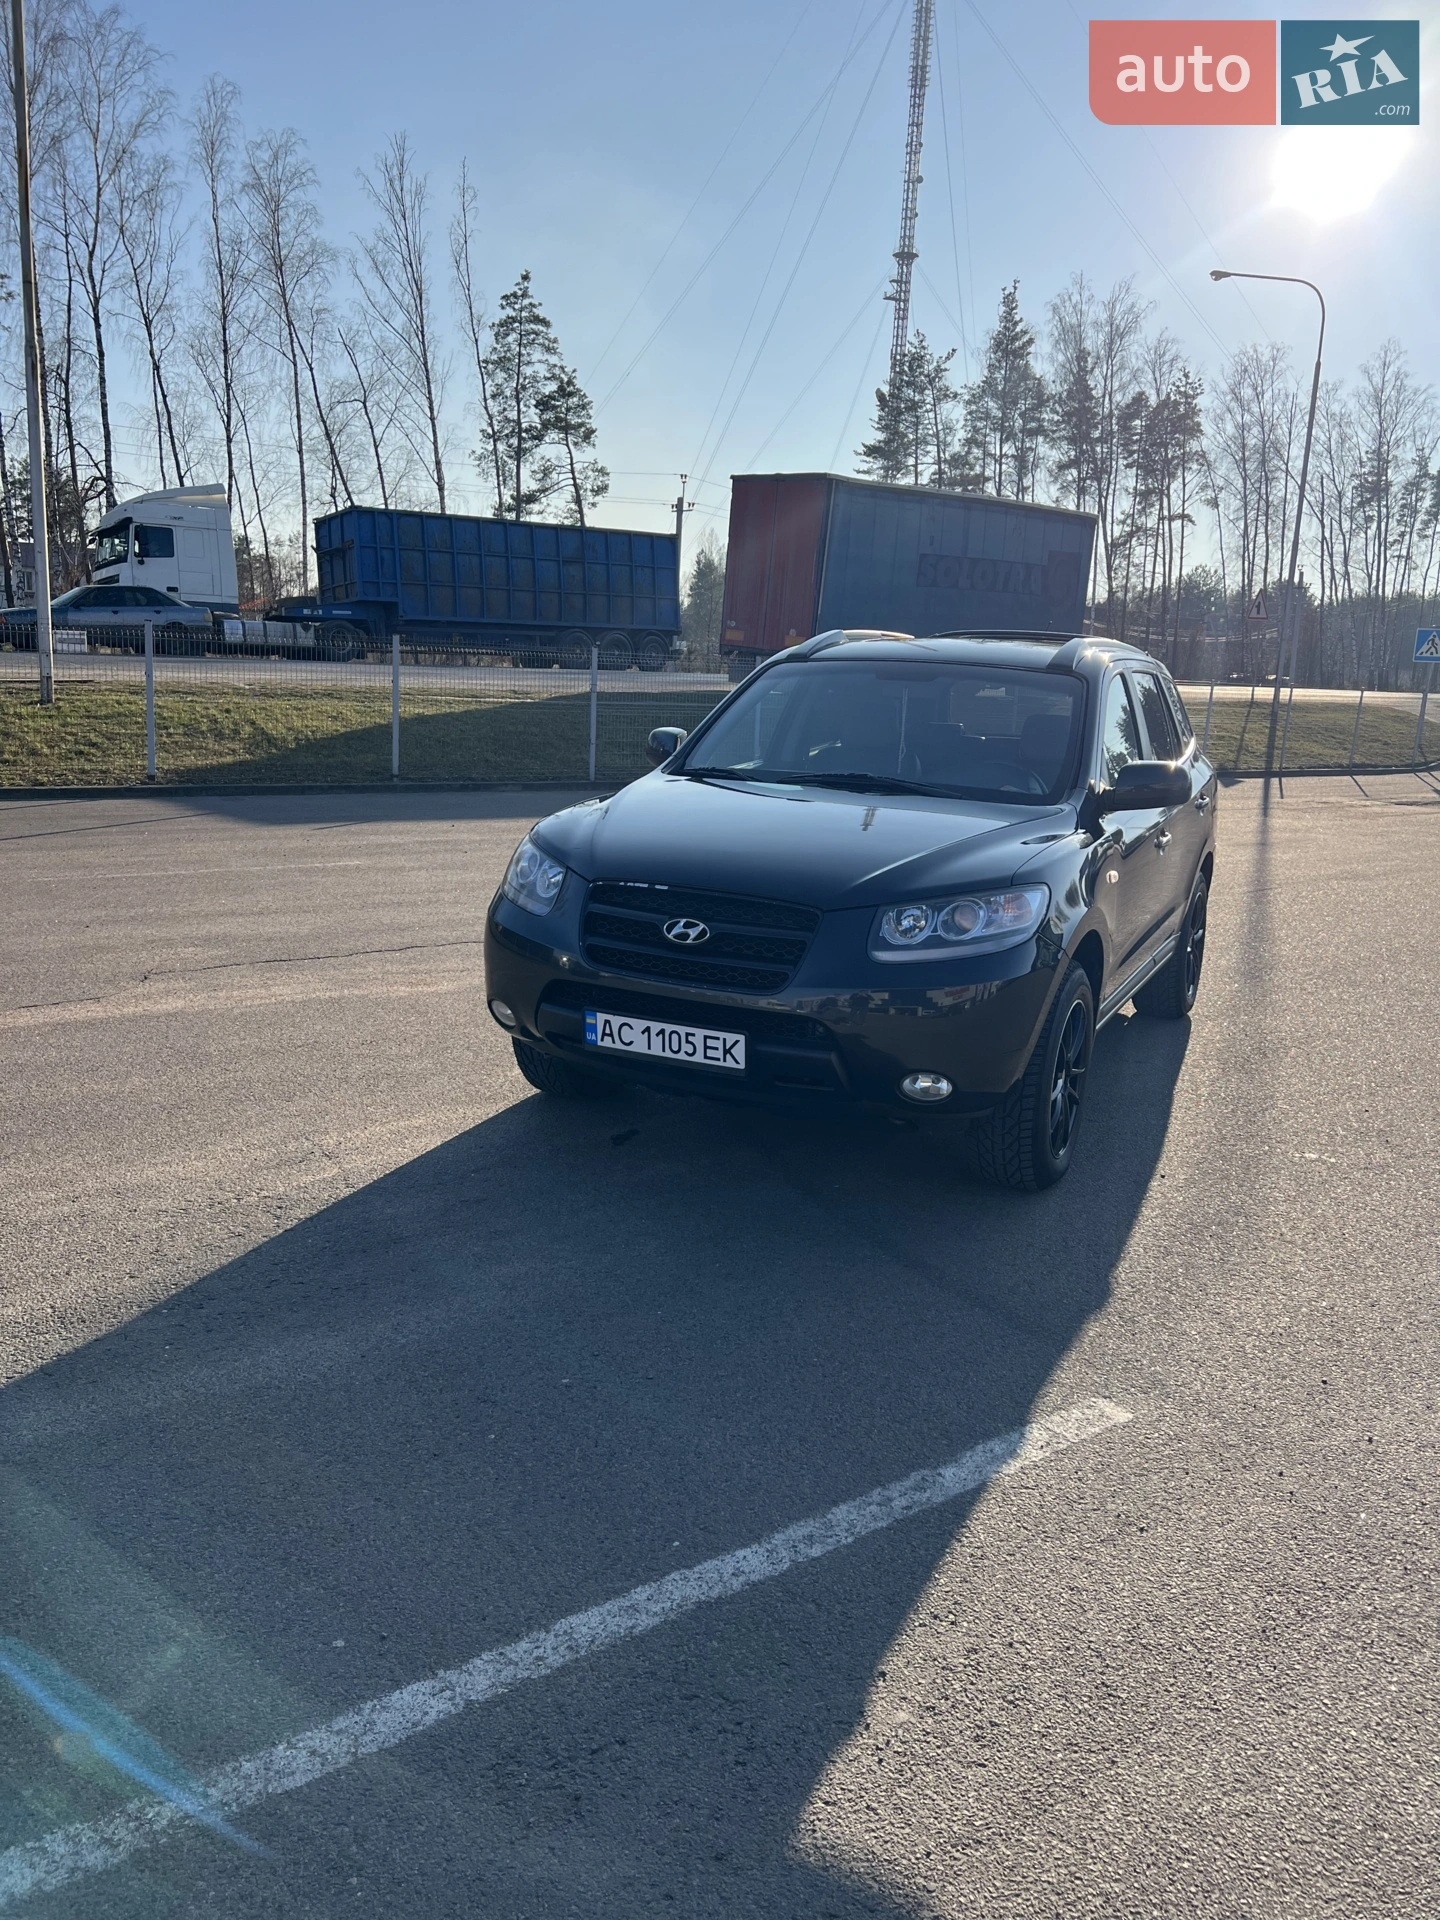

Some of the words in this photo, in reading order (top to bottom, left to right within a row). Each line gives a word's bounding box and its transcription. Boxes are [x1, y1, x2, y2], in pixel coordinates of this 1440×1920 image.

[586, 1031, 597, 1041] UA
[600, 1019, 635, 1047] AC
[640, 1025, 697, 1058] 1105
[703, 1034, 741, 1065] EK
